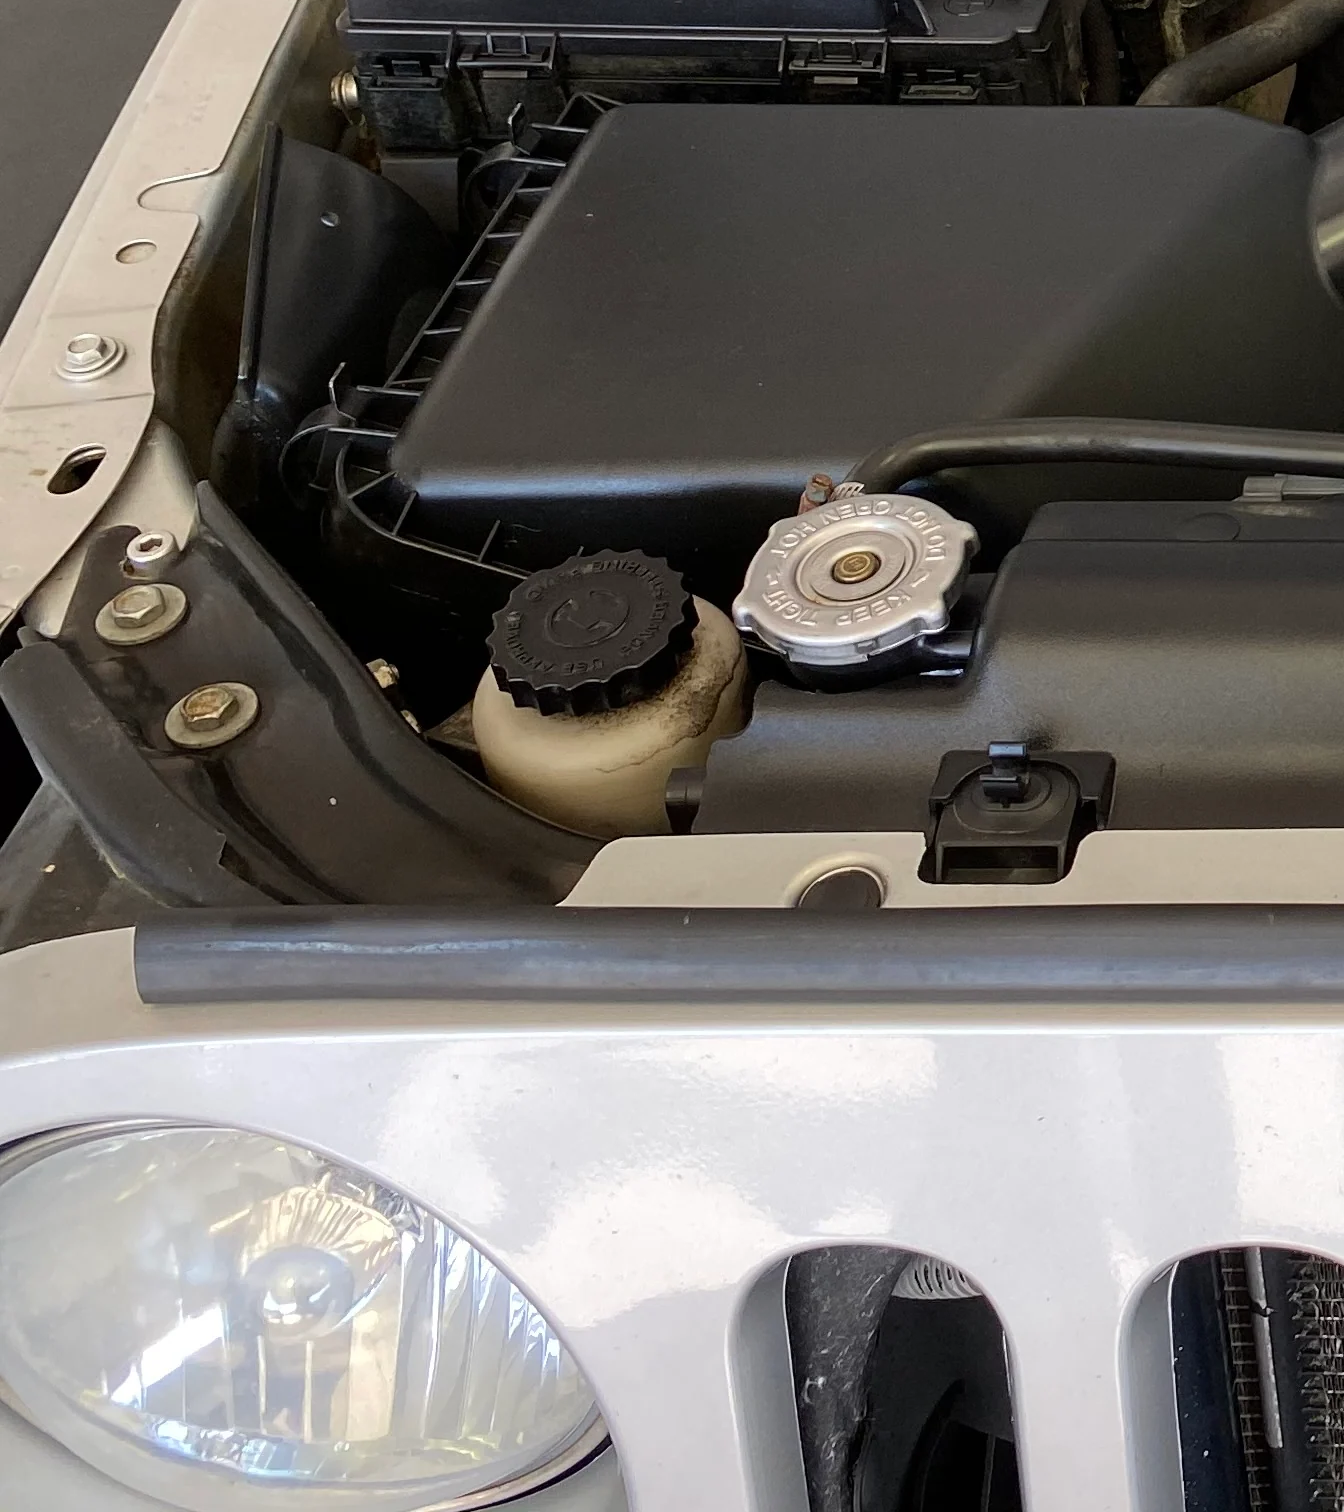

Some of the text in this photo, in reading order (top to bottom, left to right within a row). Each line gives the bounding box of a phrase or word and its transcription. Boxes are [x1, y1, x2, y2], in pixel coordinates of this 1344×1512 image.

[818, 500, 892, 525] OPEN
[770, 521, 817, 559] HOT
[925, 534, 946, 562] DO
[762, 590, 911, 628] KEEP TIGHT
